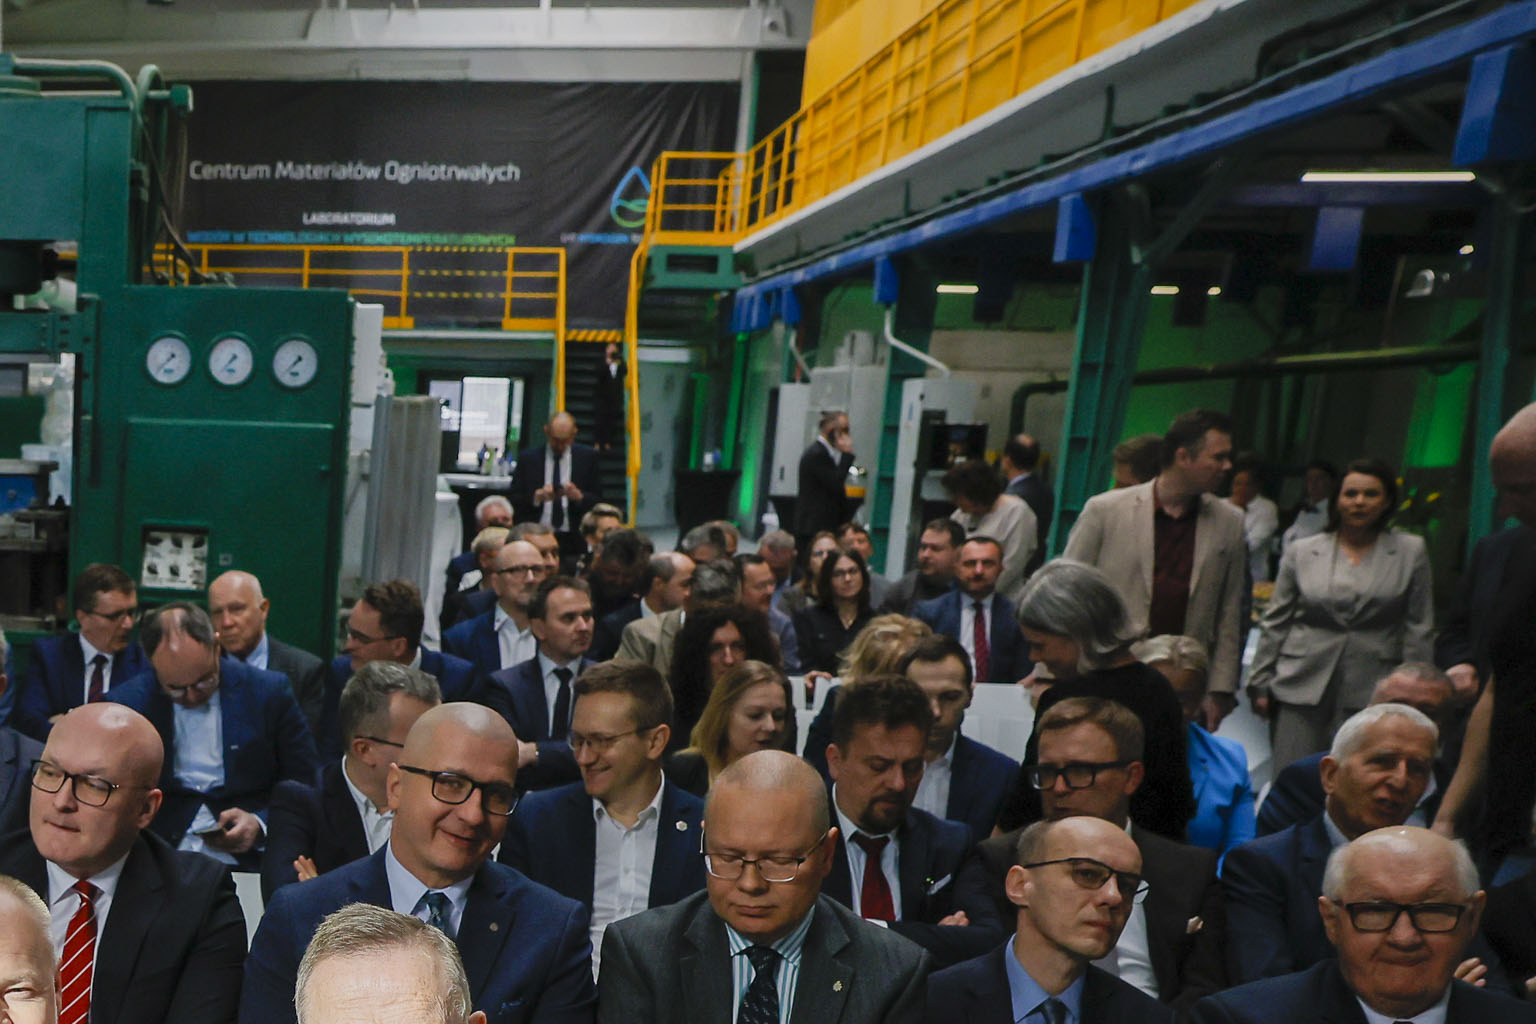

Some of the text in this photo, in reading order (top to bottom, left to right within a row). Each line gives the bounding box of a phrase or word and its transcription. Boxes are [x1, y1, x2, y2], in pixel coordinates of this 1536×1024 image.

[189, 160, 521, 185] Centrum Materiałów Ogniotrwałych
[302, 212, 396, 226] LABORATORIUM
